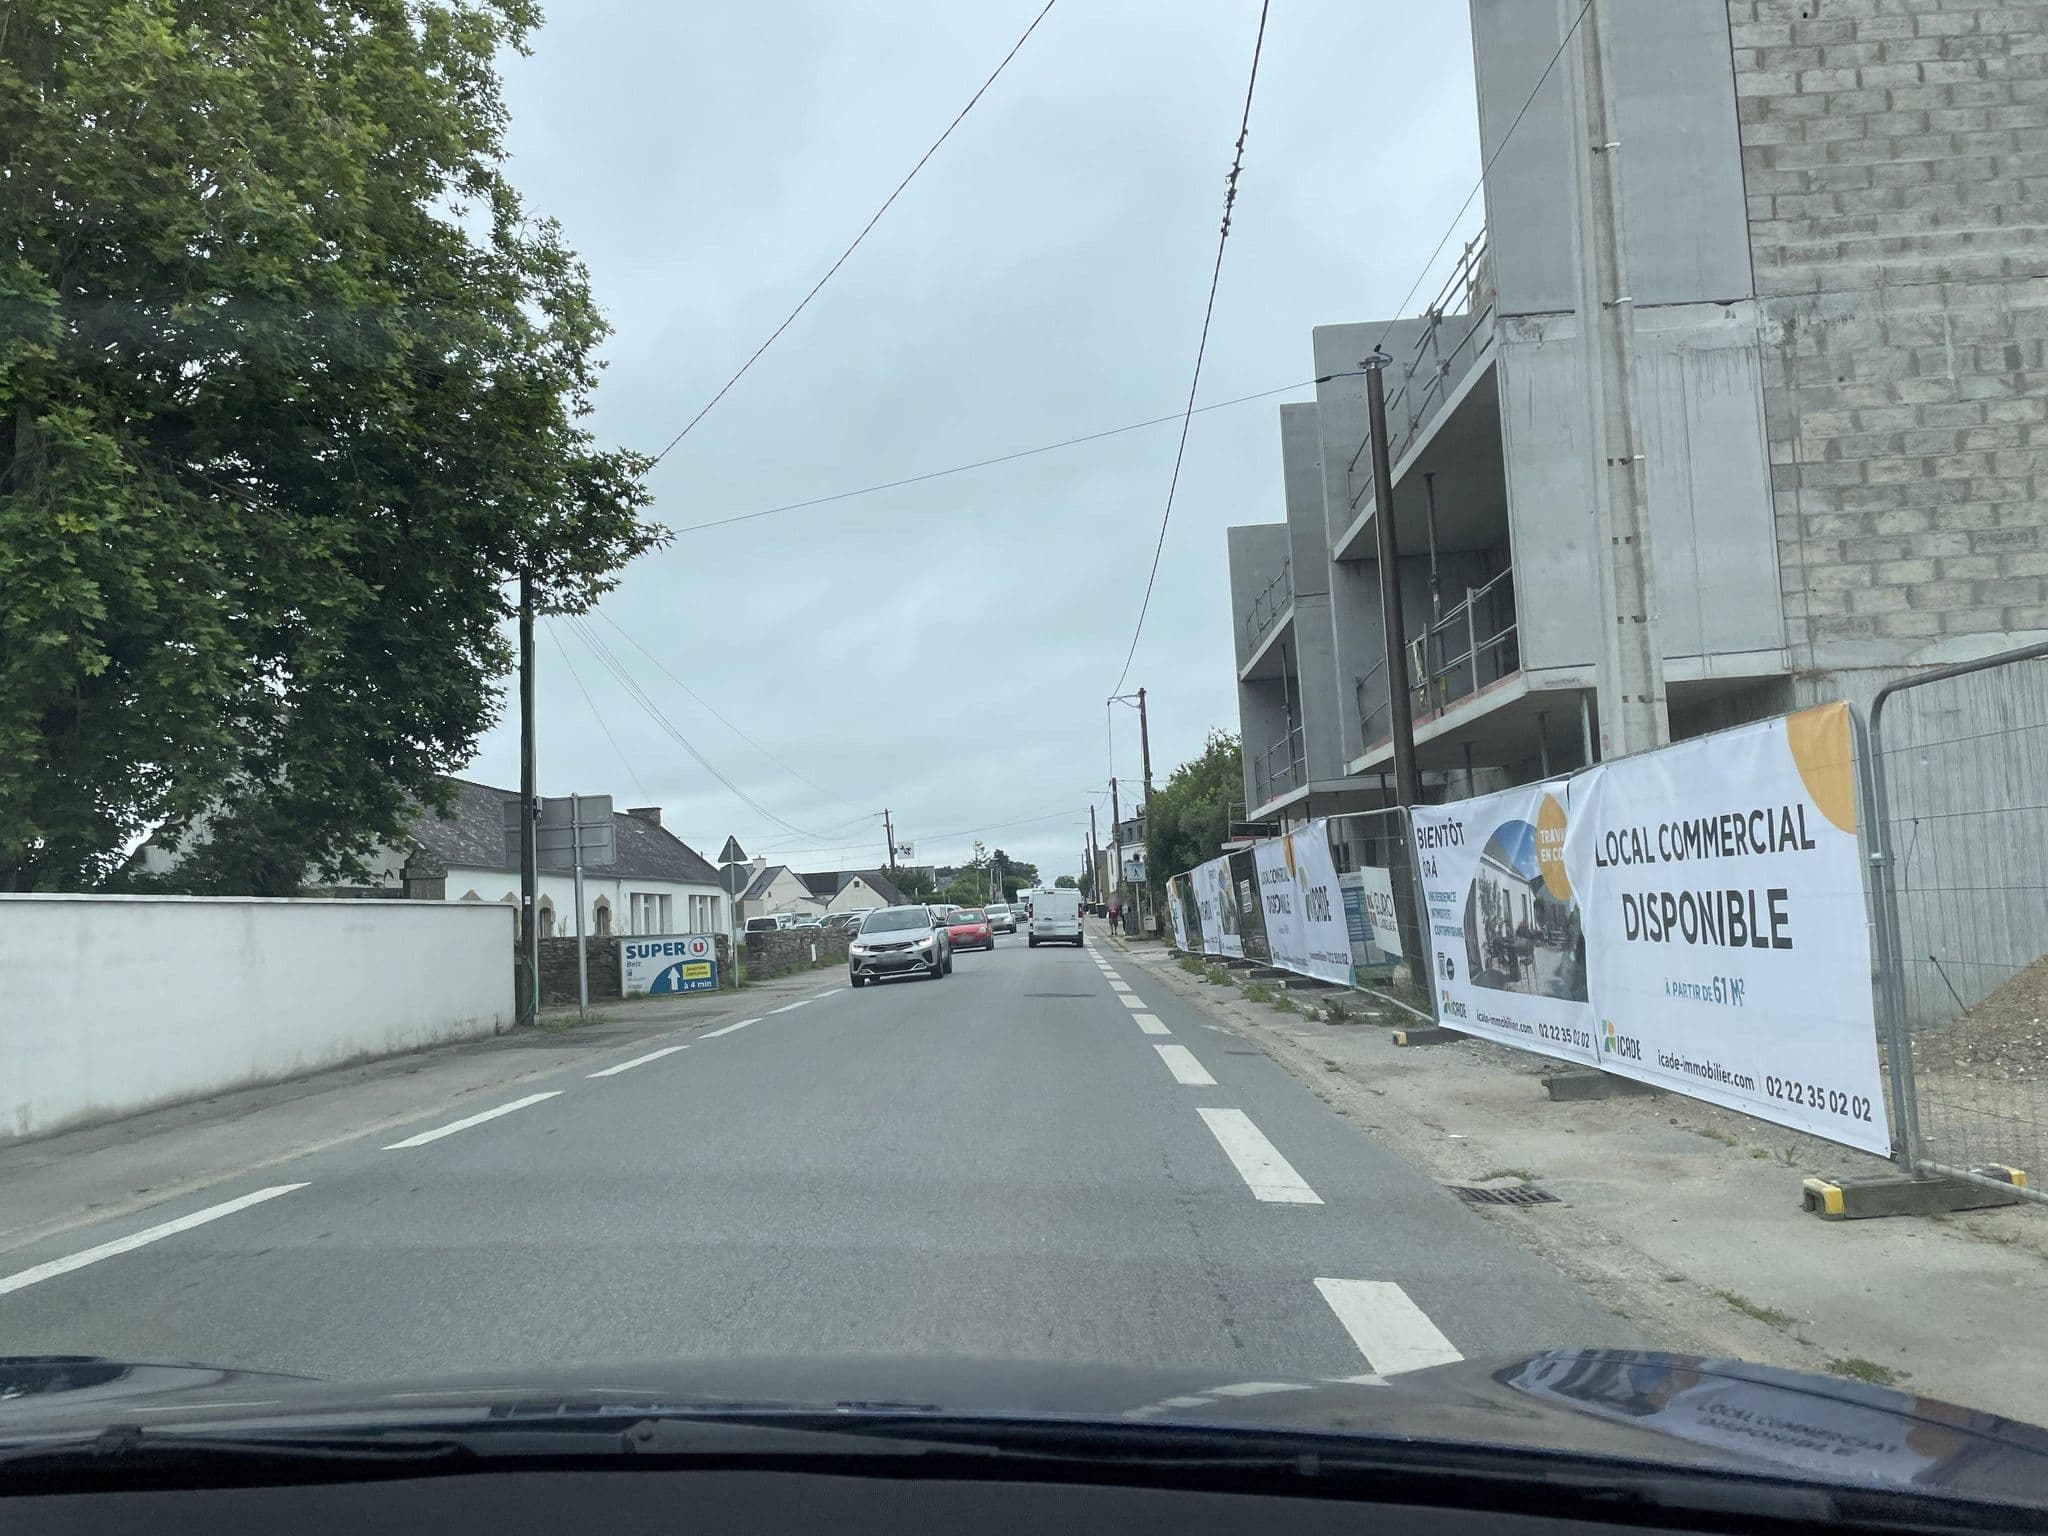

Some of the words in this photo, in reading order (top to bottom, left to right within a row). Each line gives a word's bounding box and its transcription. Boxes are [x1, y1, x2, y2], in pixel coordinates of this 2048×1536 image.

[1416, 817, 1465, 850] BIENTÔT
[1595, 826, 1656, 868] LOCAL
[1658, 803, 1816, 863] COMMERCIAL
[1621, 888, 1793, 949] DISPONIBLE
[625, 941, 686, 960] SUPER
[693, 942, 704, 953] U
[697, 980, 712, 988] min
[1672, 981, 1701, 1001] PARTIR
[1702, 985, 1713, 1002] DE
[1713, 976, 1727, 1005] 61
[1538, 1023, 1550, 1039] 02
[1550, 1025, 1561, 1041] 22
[1561, 1027, 1573, 1043] 35
[1573, 1029, 1581, 1045] 02
[1581, 1033, 1590, 1048] 02
[1617, 1035, 1642, 1061] ICADE
[1658, 1050, 1755, 1092] icade-immobilier.com
[1766, 1075, 1784, 1100] 02
[1784, 1080, 1803, 1105] 22
[1807, 1085, 1826, 1110] 35
[1829, 1090, 1849, 1116] 02
[1852, 1095, 1873, 1122] 02
